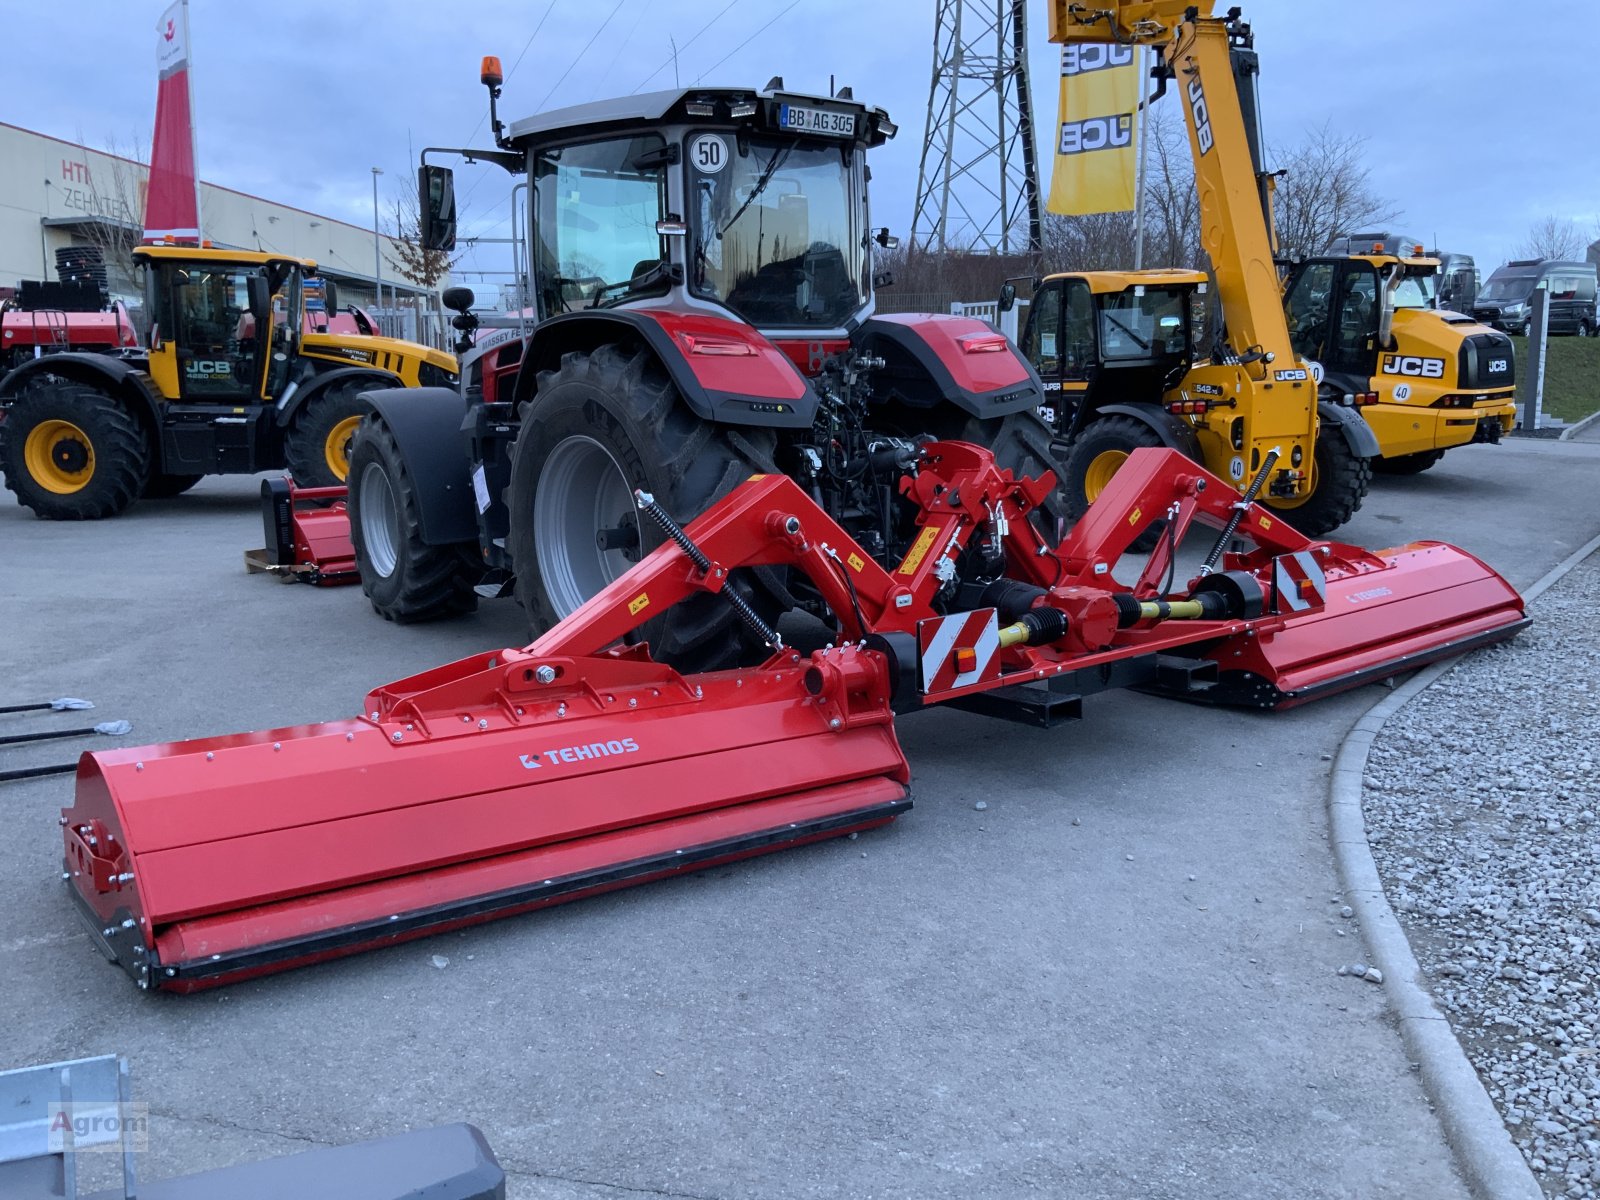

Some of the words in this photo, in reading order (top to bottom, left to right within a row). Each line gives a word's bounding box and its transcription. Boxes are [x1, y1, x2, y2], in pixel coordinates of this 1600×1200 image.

[789, 109, 805, 127] BB
[813, 112, 829, 130] AG
[831, 114, 853, 133] 305
[1189, 79, 1213, 155] JCB
[699, 142, 720, 166] 50
[482, 331, 509, 350] MASSEY
[186, 361, 231, 373] JCB
[1276, 370, 1307, 381] JCB
[1384, 356, 1444, 378] JCB
[1488, 360, 1507, 373] JCB
[1395, 386, 1408, 399] 40
[1232, 460, 1242, 476] 40
[543, 738, 640, 765] TEHNOS
